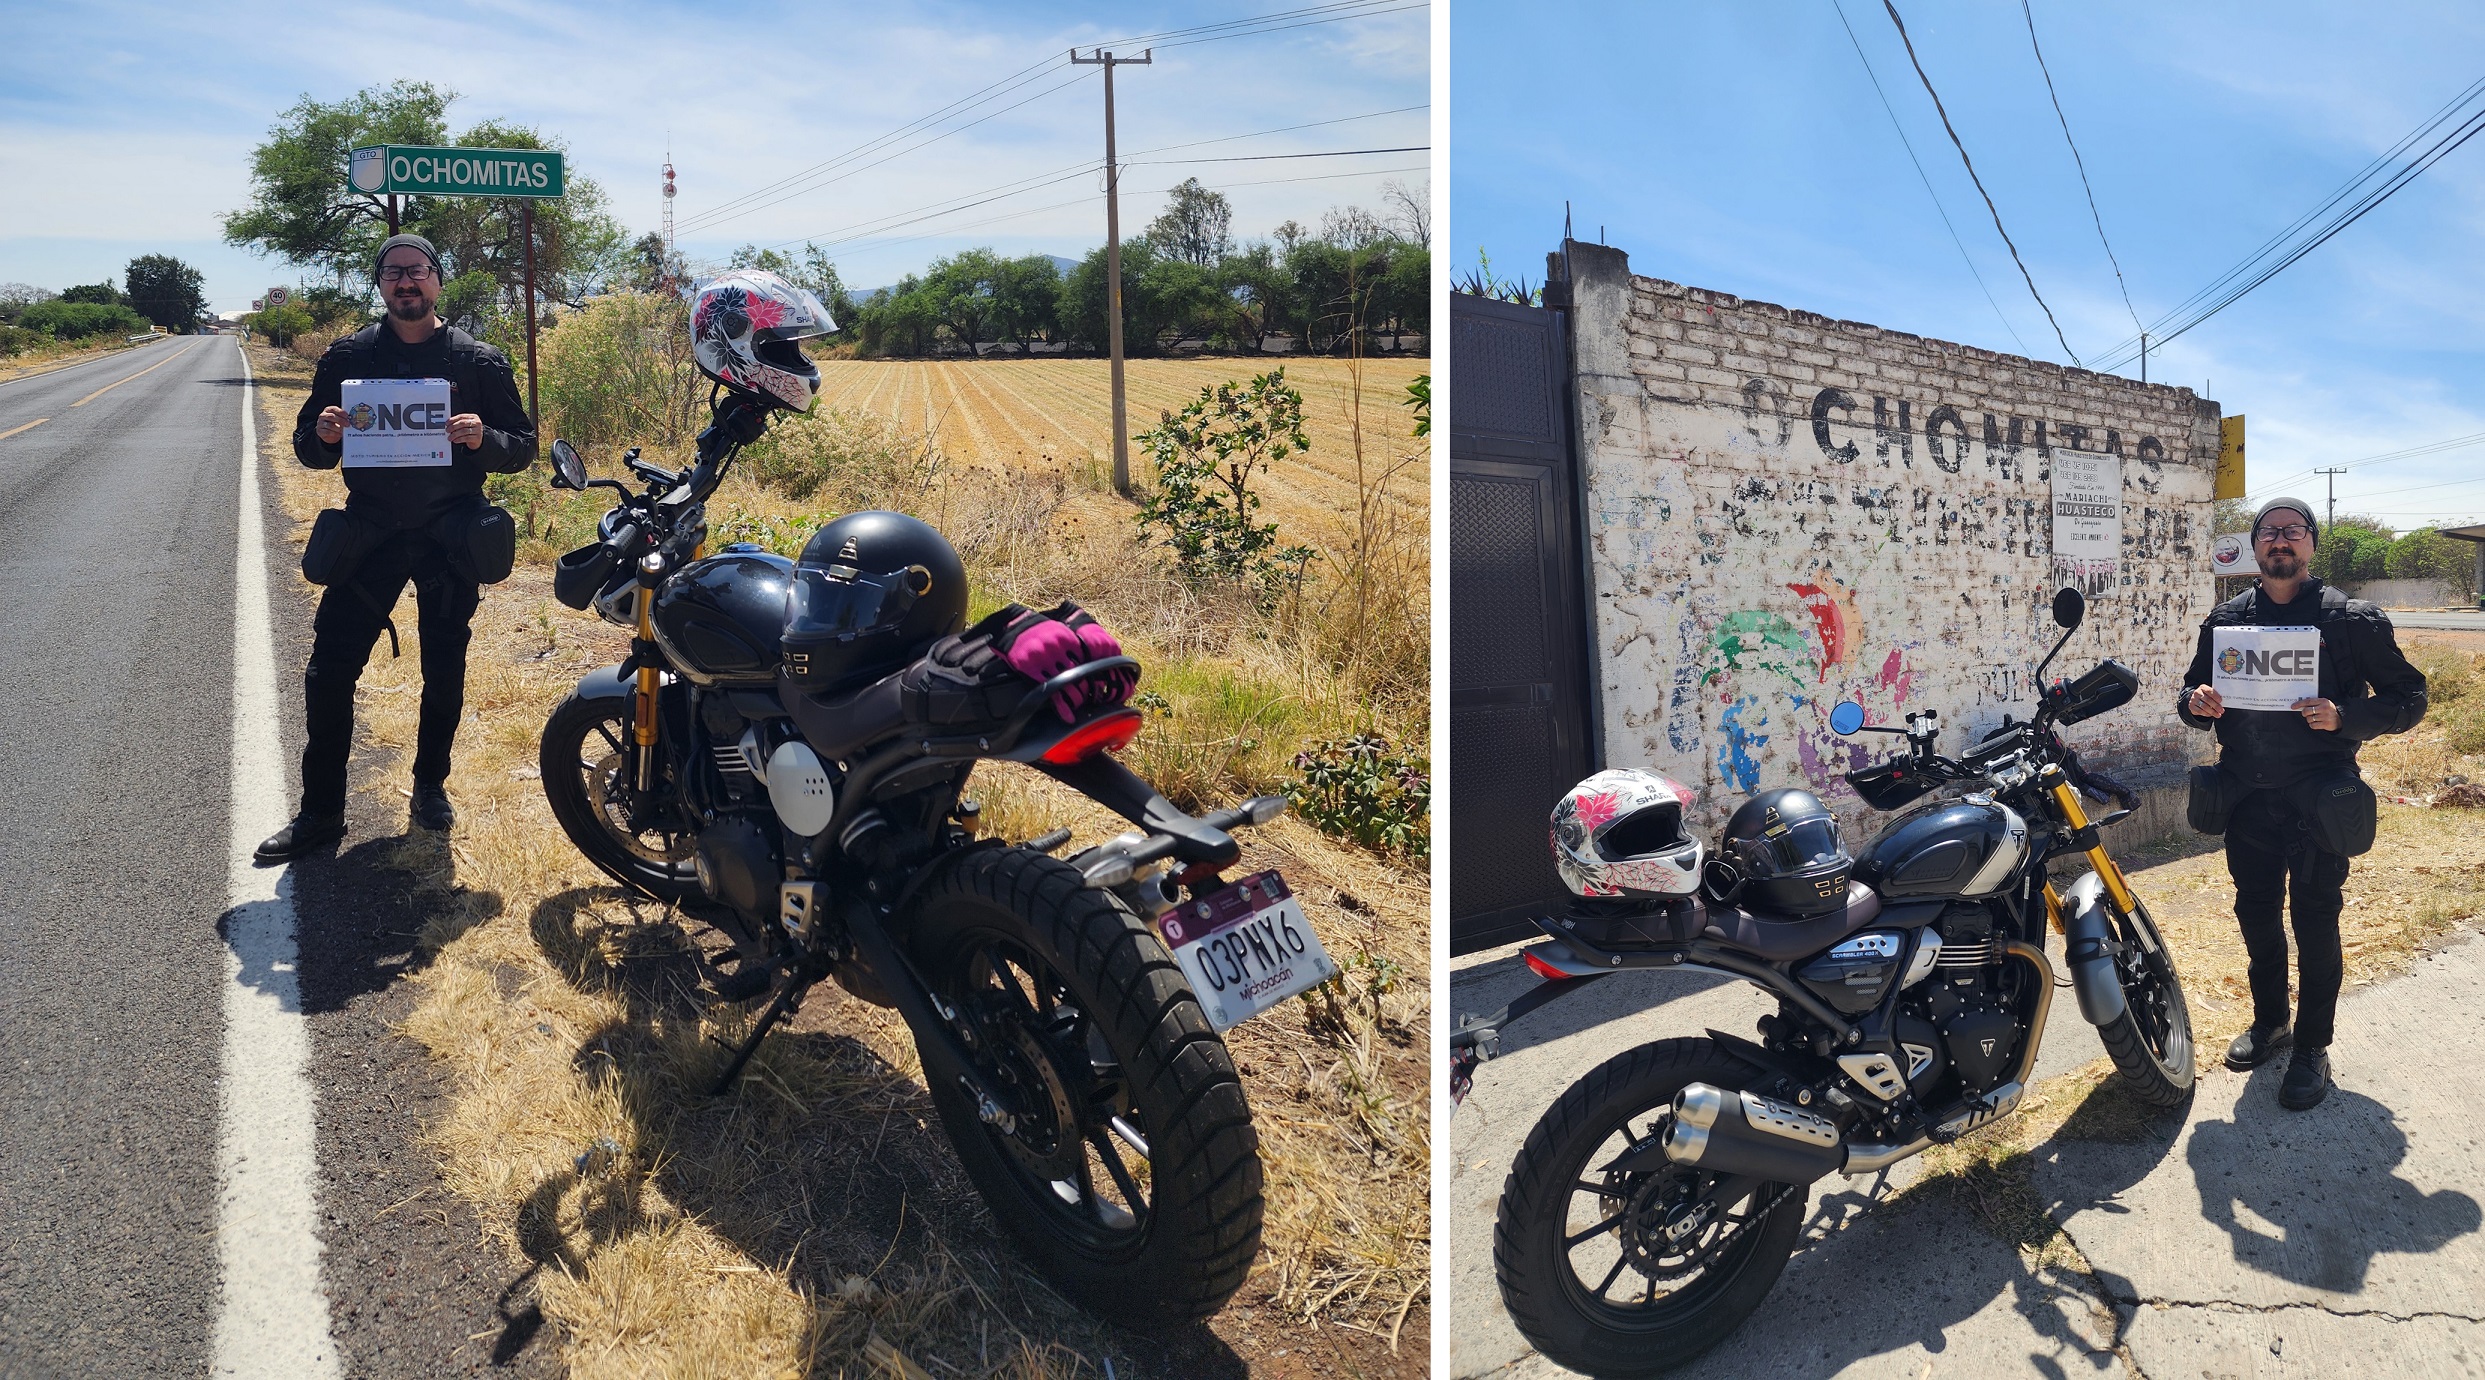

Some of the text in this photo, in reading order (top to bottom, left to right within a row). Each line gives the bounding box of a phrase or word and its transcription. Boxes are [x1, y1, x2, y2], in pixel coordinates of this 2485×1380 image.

[359, 151, 377, 160] GTO
[390, 155, 549, 188] OCHOMITAS
[273, 291, 283, 299] 40
[2064, 492, 2108, 503] MARIACHI
[2057, 504, 2115, 517] HUASTECO
[1195, 910, 1305, 992] 03PNX6
[1239, 967, 1294, 1001] Michoacán
